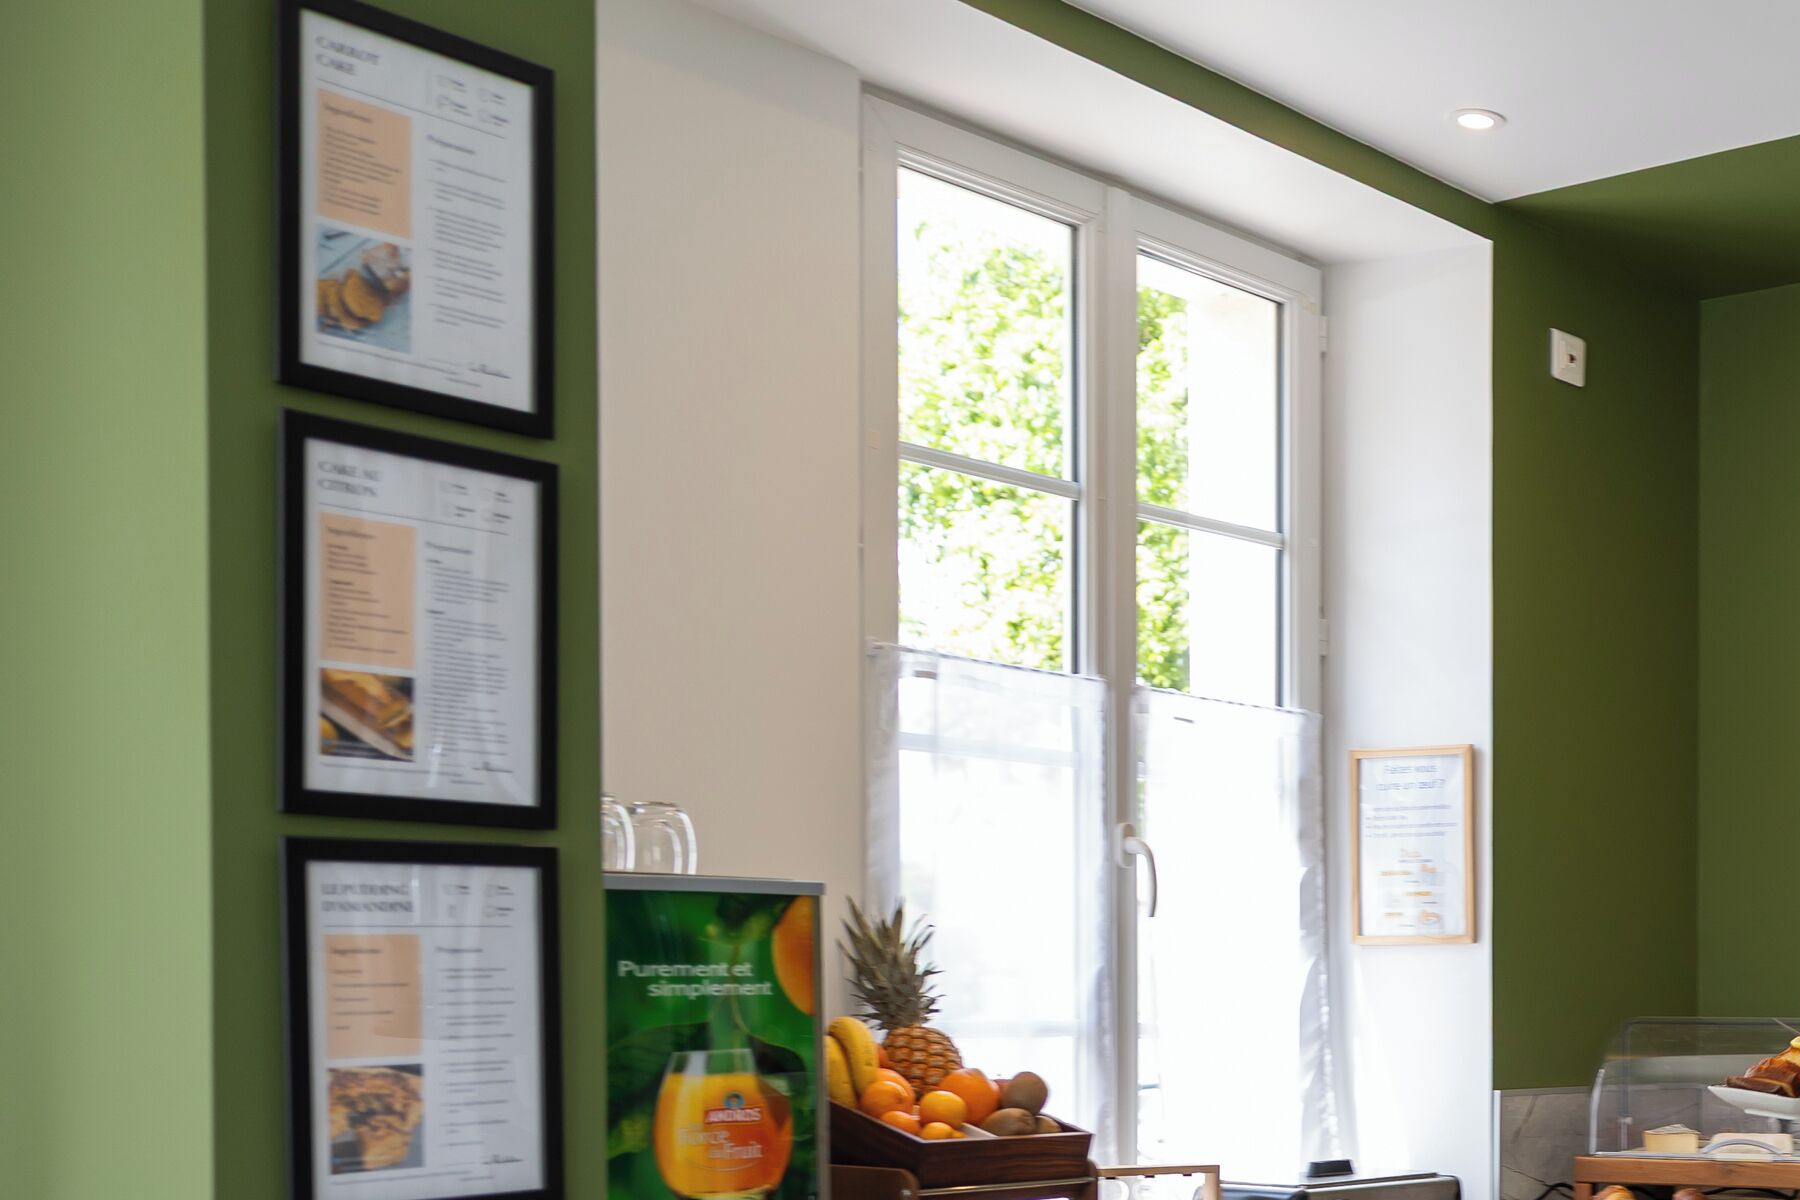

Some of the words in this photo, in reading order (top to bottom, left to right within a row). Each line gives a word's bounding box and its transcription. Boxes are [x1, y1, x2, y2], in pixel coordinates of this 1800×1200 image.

[317, 461, 359, 478] CAKE
[317, 478, 378, 497] CITRON
[617, 960, 730, 977] Purement
[731, 962, 754, 977] et
[647, 979, 774, 1000] simplement
[706, 1108, 762, 1121] ANDROS
